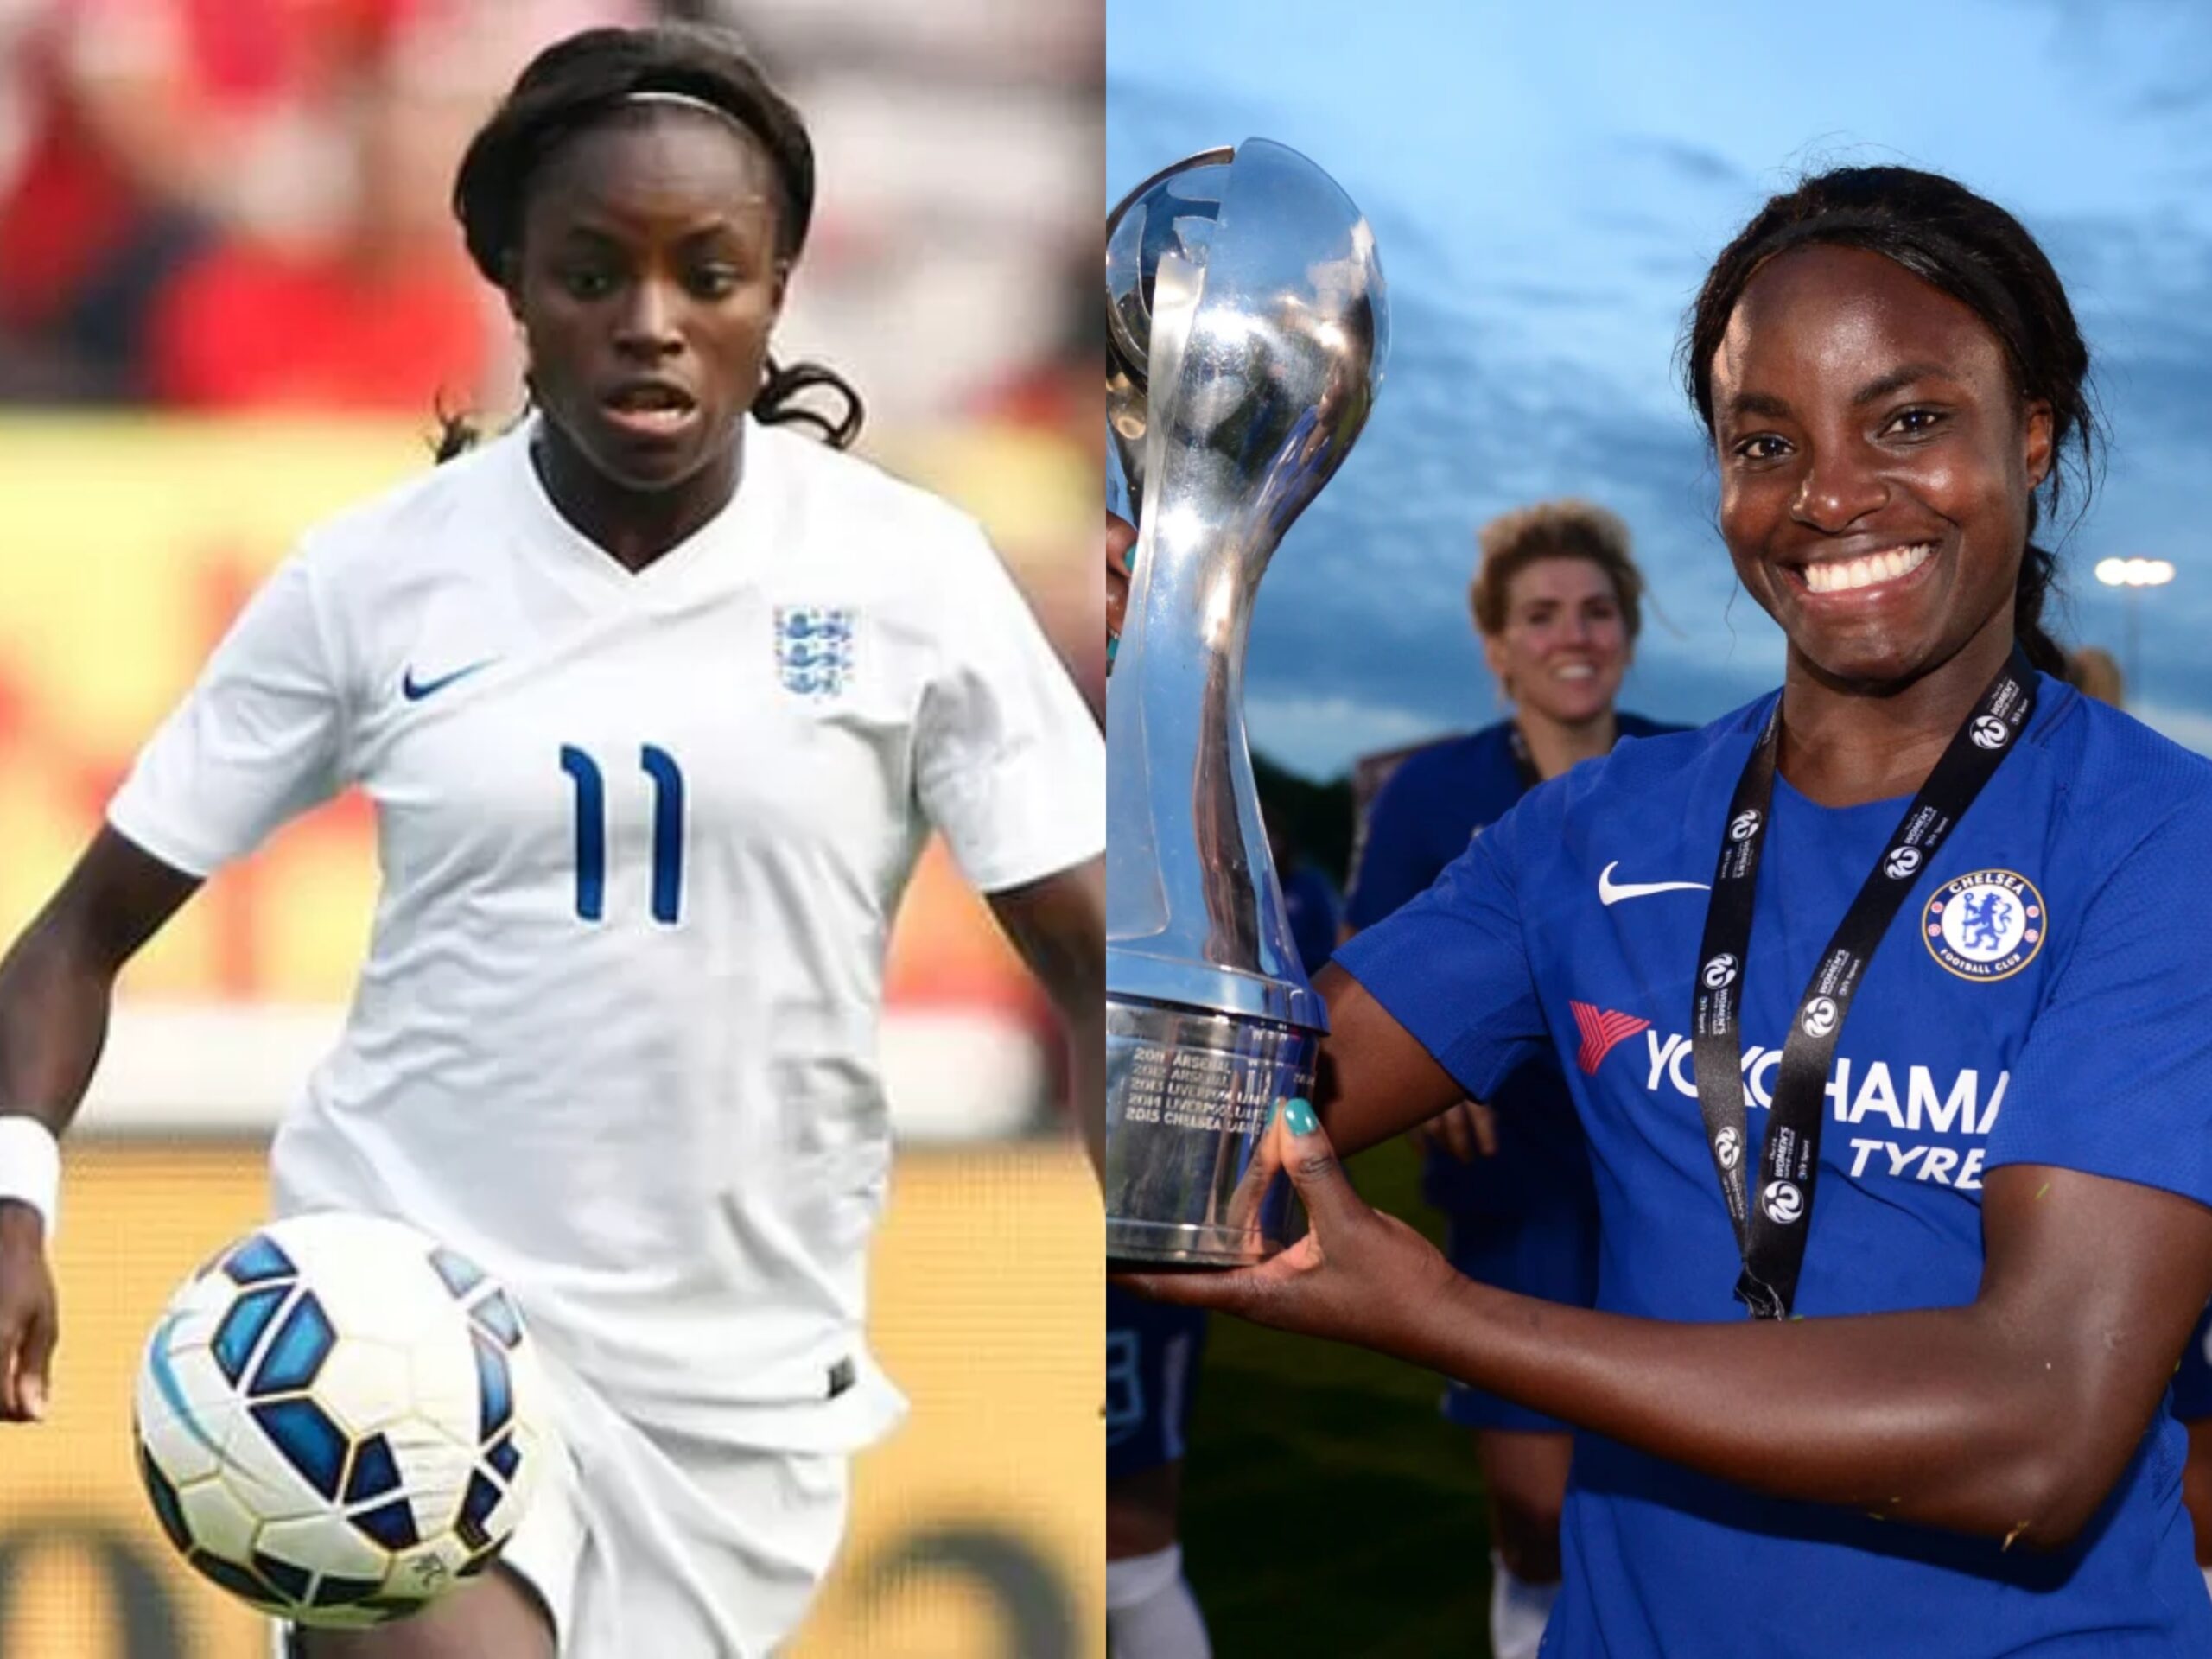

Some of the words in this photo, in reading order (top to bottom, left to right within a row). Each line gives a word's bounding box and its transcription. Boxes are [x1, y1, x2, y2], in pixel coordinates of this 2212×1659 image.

[560, 742, 683, 923] 11
[1948, 873, 2024, 895] CHELSEA
[1940, 949, 1991, 974] FOOTBALL
[1994, 953, 2021, 971] CLUB
[1125, 1107, 1160, 1122] 2015
[1164, 1111, 1221, 1131] CHELSEA
